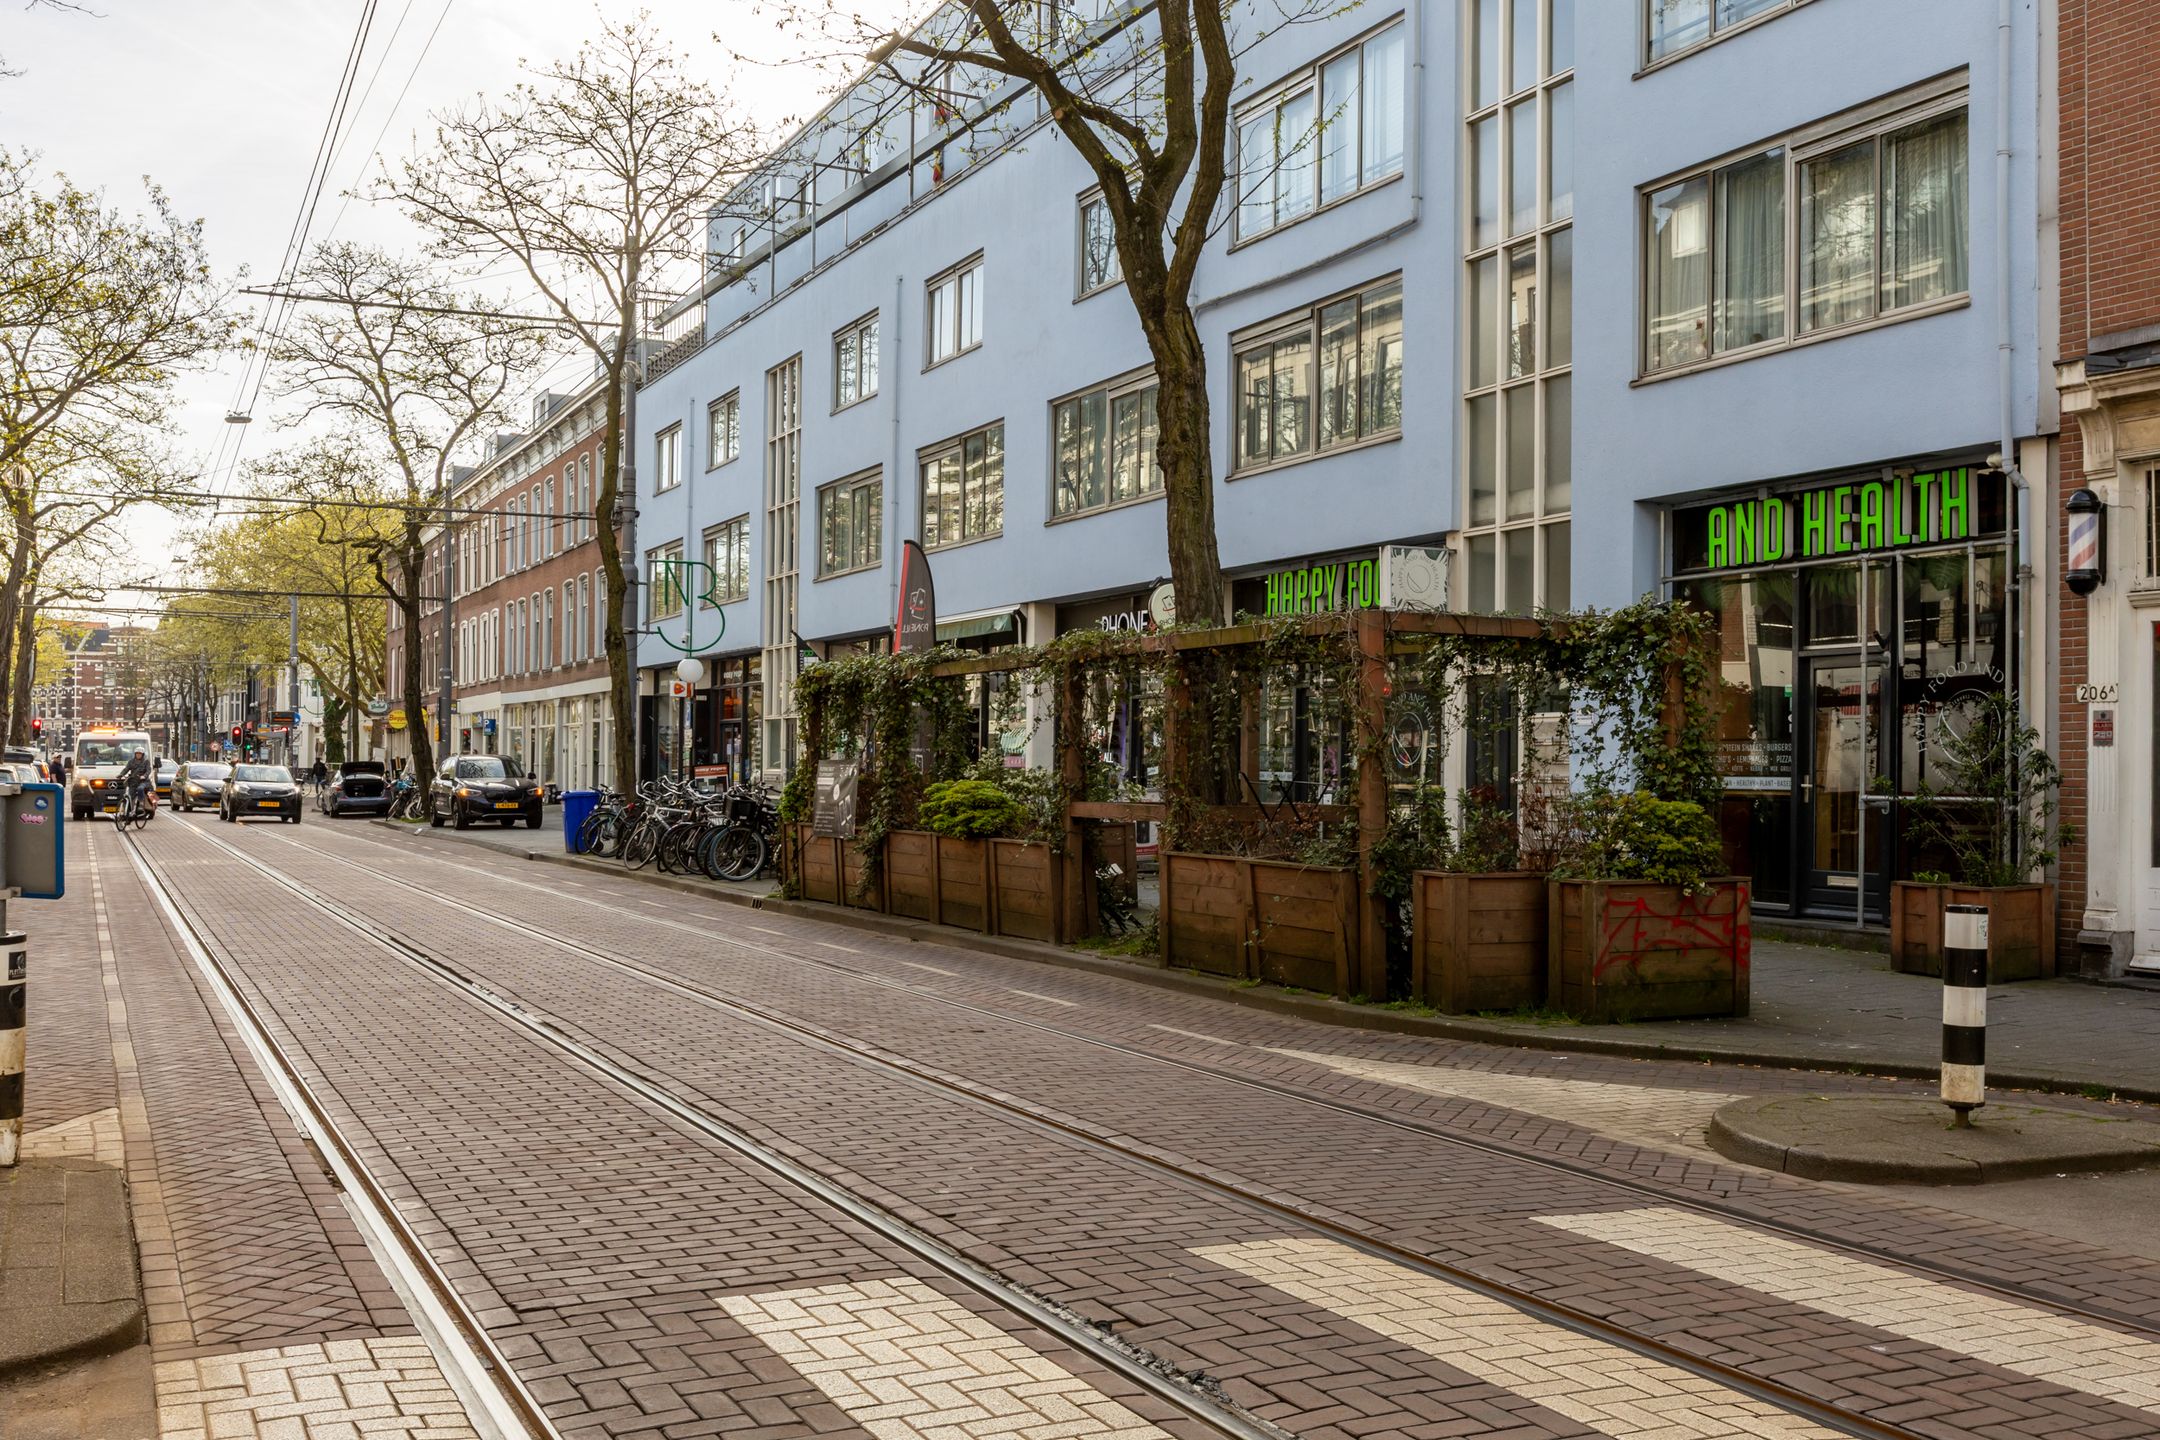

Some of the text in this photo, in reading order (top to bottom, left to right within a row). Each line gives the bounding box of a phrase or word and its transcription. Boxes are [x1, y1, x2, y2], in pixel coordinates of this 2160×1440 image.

[1708, 467, 1968, 568] AND HEALTH
[1266, 563, 1338, 618] HAPPY
[1915, 661, 2005, 753] HAPPY FOOD AND
[2080, 685, 2116, 701] 206A
[1766, 743, 1793, 752] BURGERS
[1776, 755, 1793, 764] PIZZA
